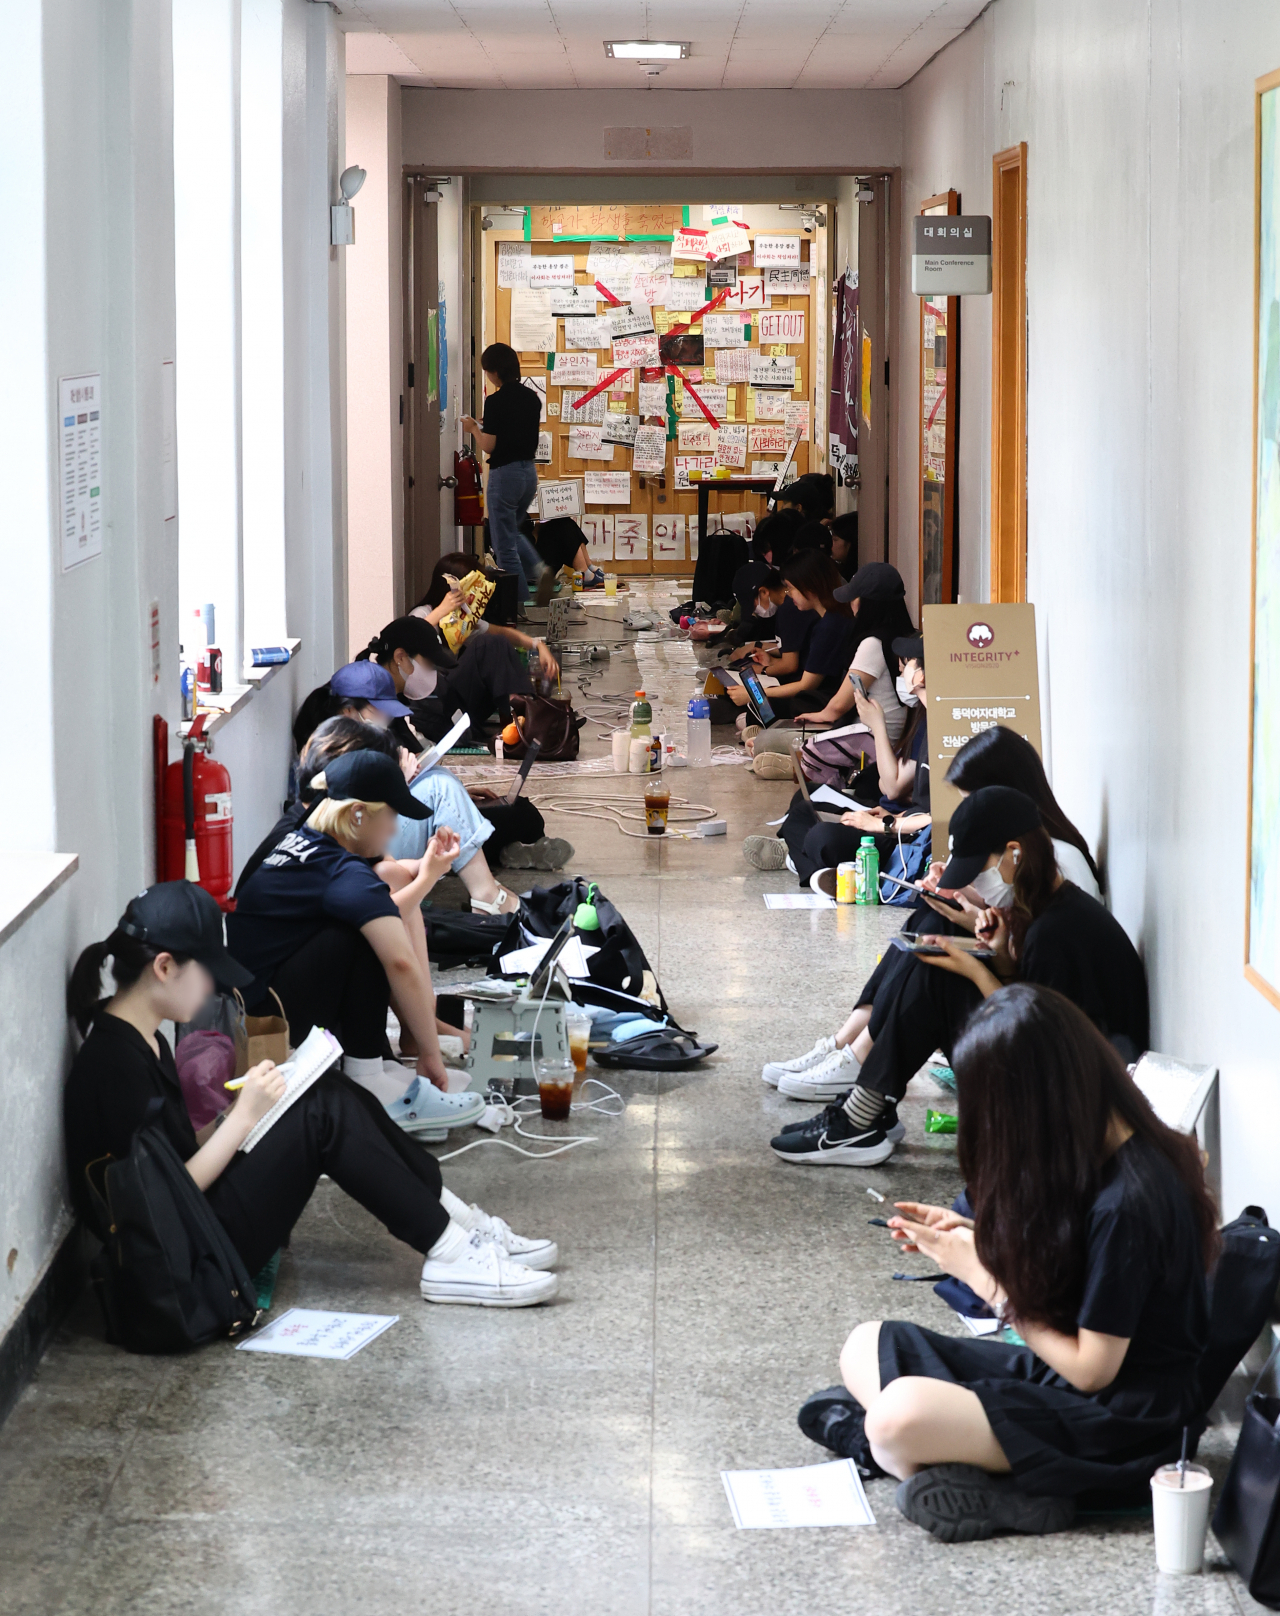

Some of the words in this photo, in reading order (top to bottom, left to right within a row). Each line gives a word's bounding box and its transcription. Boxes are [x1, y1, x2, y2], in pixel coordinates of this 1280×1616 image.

[542, 212, 581, 231] 학교가
[590, 212, 634, 231] 학생을
[638, 212, 679, 231] 죽였다
[923, 227, 973, 238] 대회의실
[633, 274, 668, 289] 살인자의
[644, 288, 658, 304] 방
[761, 314, 782, 337] GET
[783, 314, 805, 337] OUT
[558, 356, 590, 368] 살인자
[752, 436, 788, 450] 사퇴하라
[675, 457, 719, 470] 나가라
[584, 518, 611, 546] 가
[951, 707, 1017, 721] 동덕여자대학교
